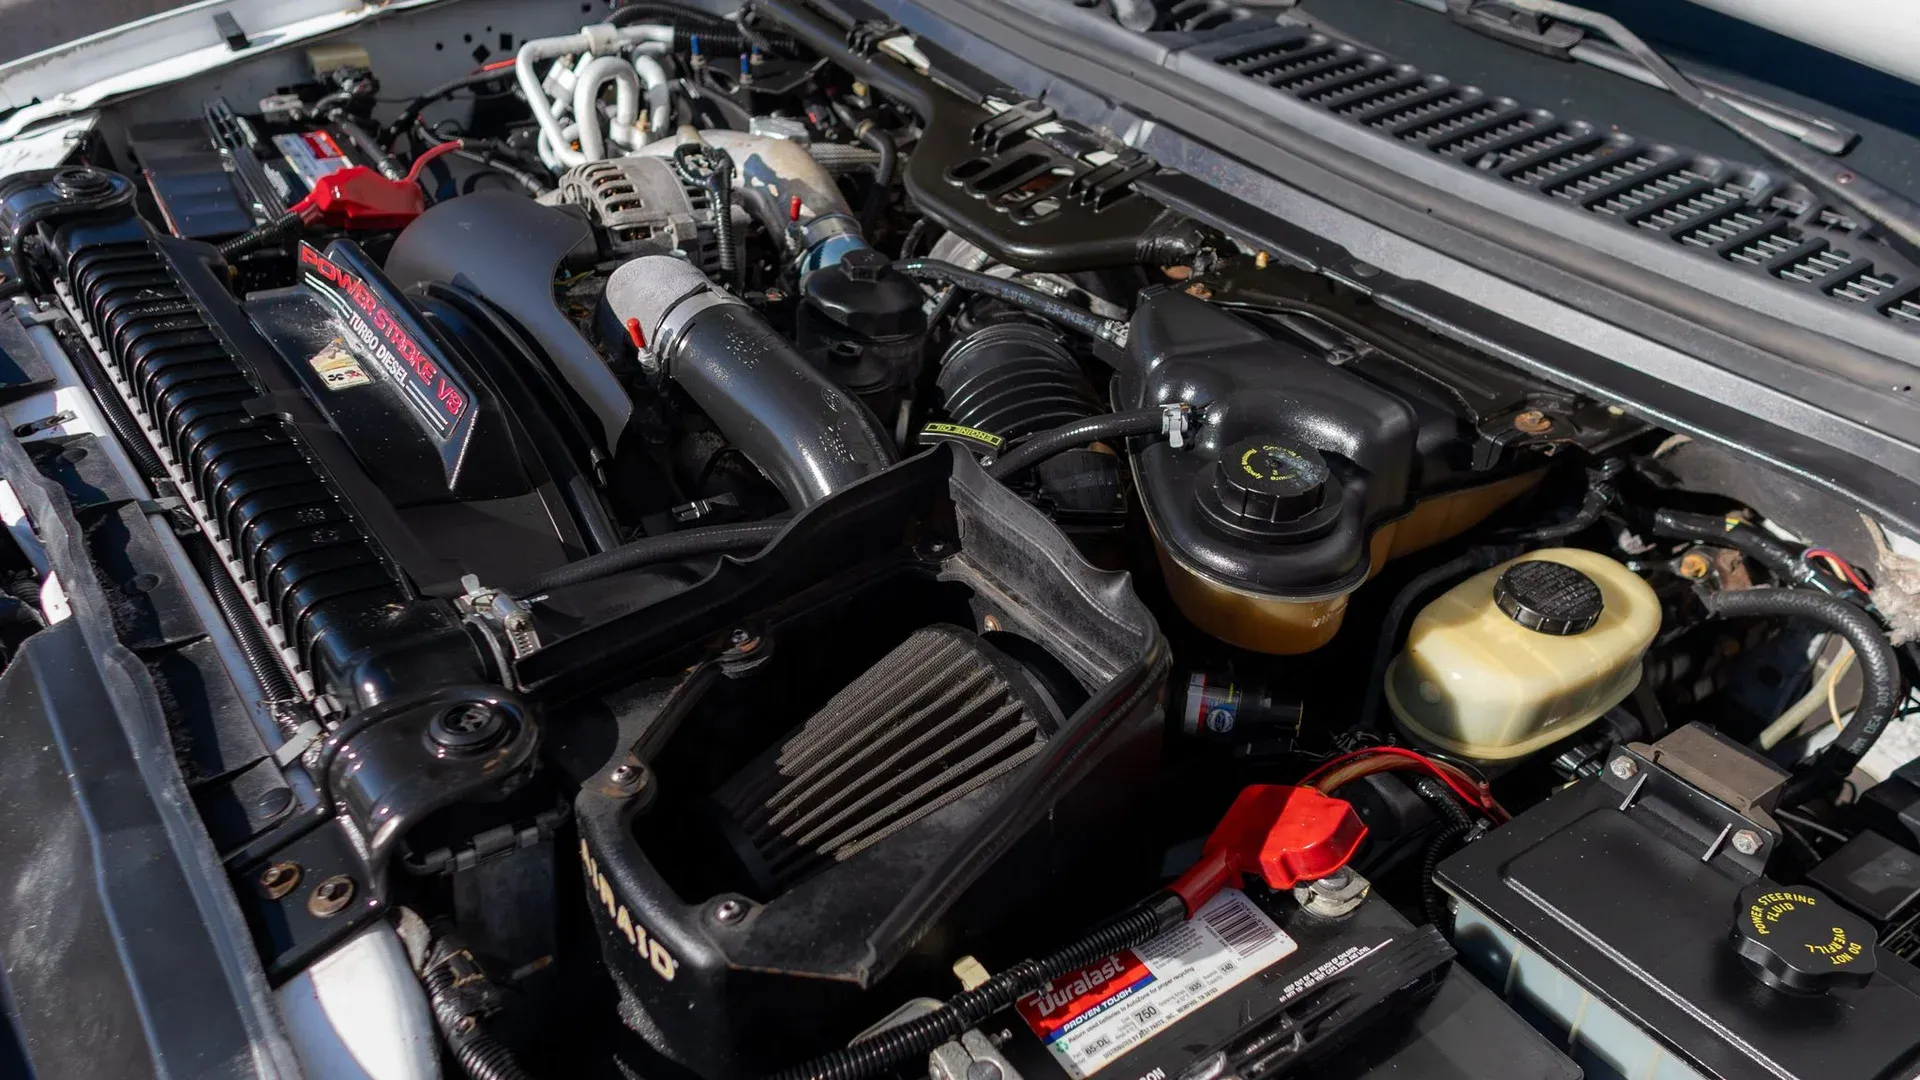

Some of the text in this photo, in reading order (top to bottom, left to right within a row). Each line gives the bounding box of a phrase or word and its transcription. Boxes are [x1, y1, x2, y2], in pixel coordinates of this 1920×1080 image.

[300, 245, 377, 317] POWER
[373, 310, 438, 386] STROKE
[436, 377, 463, 416] V8
[349, 310, 408, 388] TURBO DIESEL
[936, 423, 993, 442] ENGINE OIL
[1751, 892, 1816, 935] POWER STEERING
[1767, 902, 1795, 922] FLUID
[1805, 927, 1846, 954] OVERFILL
[1830, 942, 1862, 965] DO NOT
[1221, 963, 1234, 973] 140
[1284, 983, 1295, 993] KEEP
[1294, 978, 1304, 987] OUT
[1309, 968, 1319, 977] THE
[1318, 961, 1333, 972] REACH
[1337, 946, 1358, 960] CHILDREN
[1029, 954, 1125, 1018] Duralast
[1063, 1005, 1101, 1032] PROVEN
[1100, 987, 1133, 1010] TOUGH
[1135, 1005, 1158, 1023] 750
[1085, 1037, 1111, 1056] 65-DL
[1102, 1038, 1134, 1060] DISTRIBUTED
